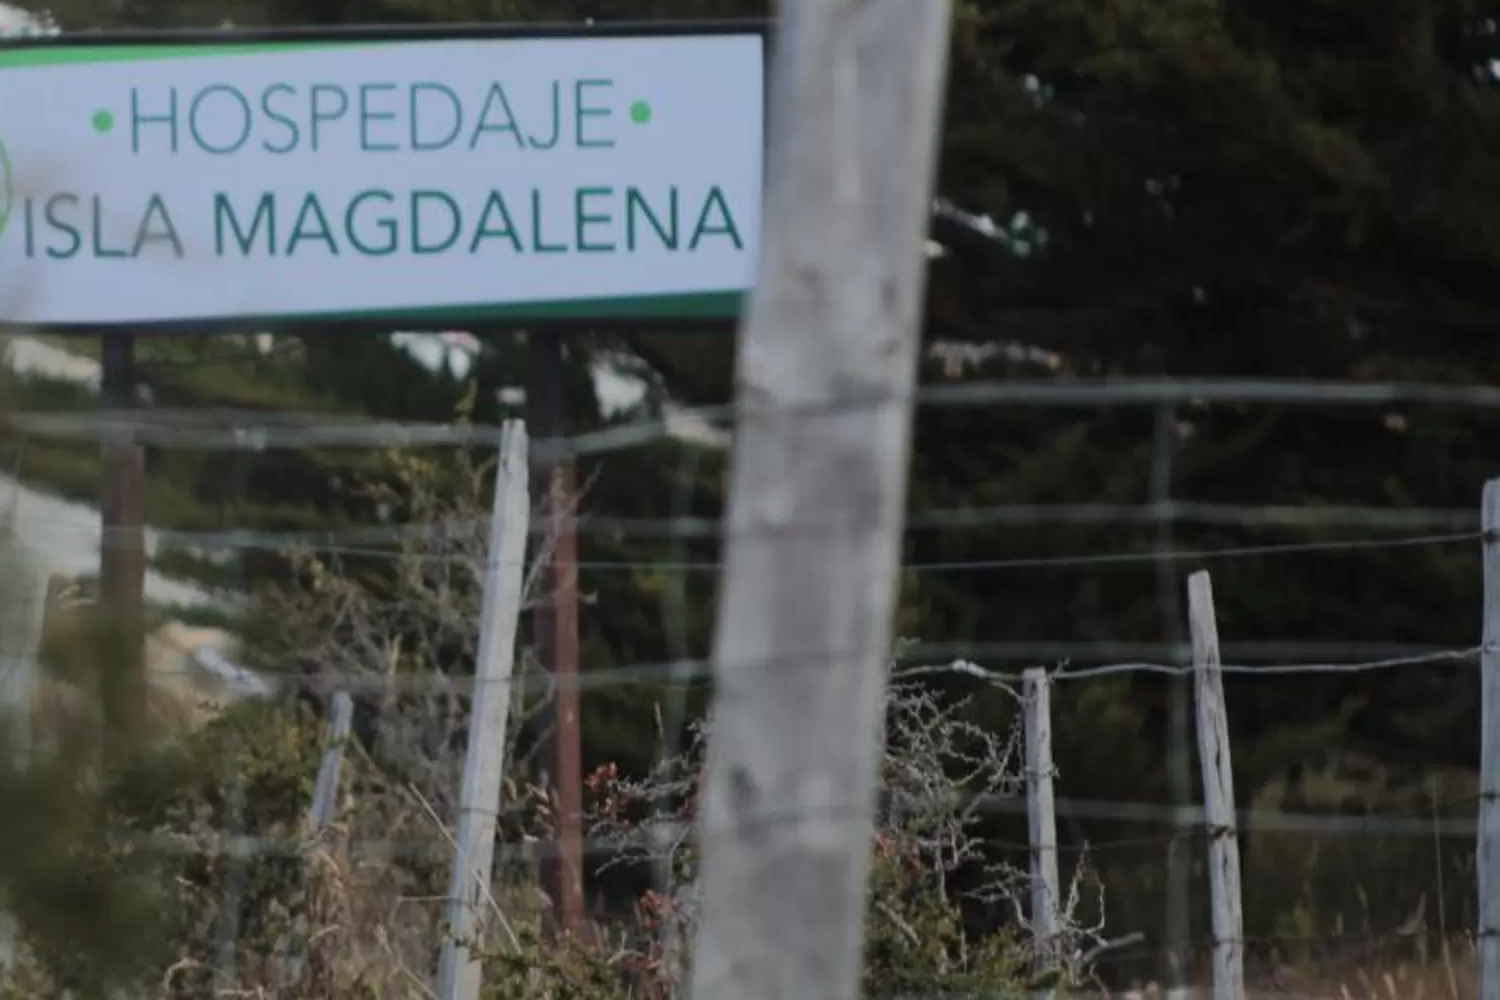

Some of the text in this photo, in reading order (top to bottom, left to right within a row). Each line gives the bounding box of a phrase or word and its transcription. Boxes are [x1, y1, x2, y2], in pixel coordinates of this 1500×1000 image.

[130, 78, 615, 156] HOSPEDAJE
[23, 185, 744, 259] ISLA MAGDALENA
